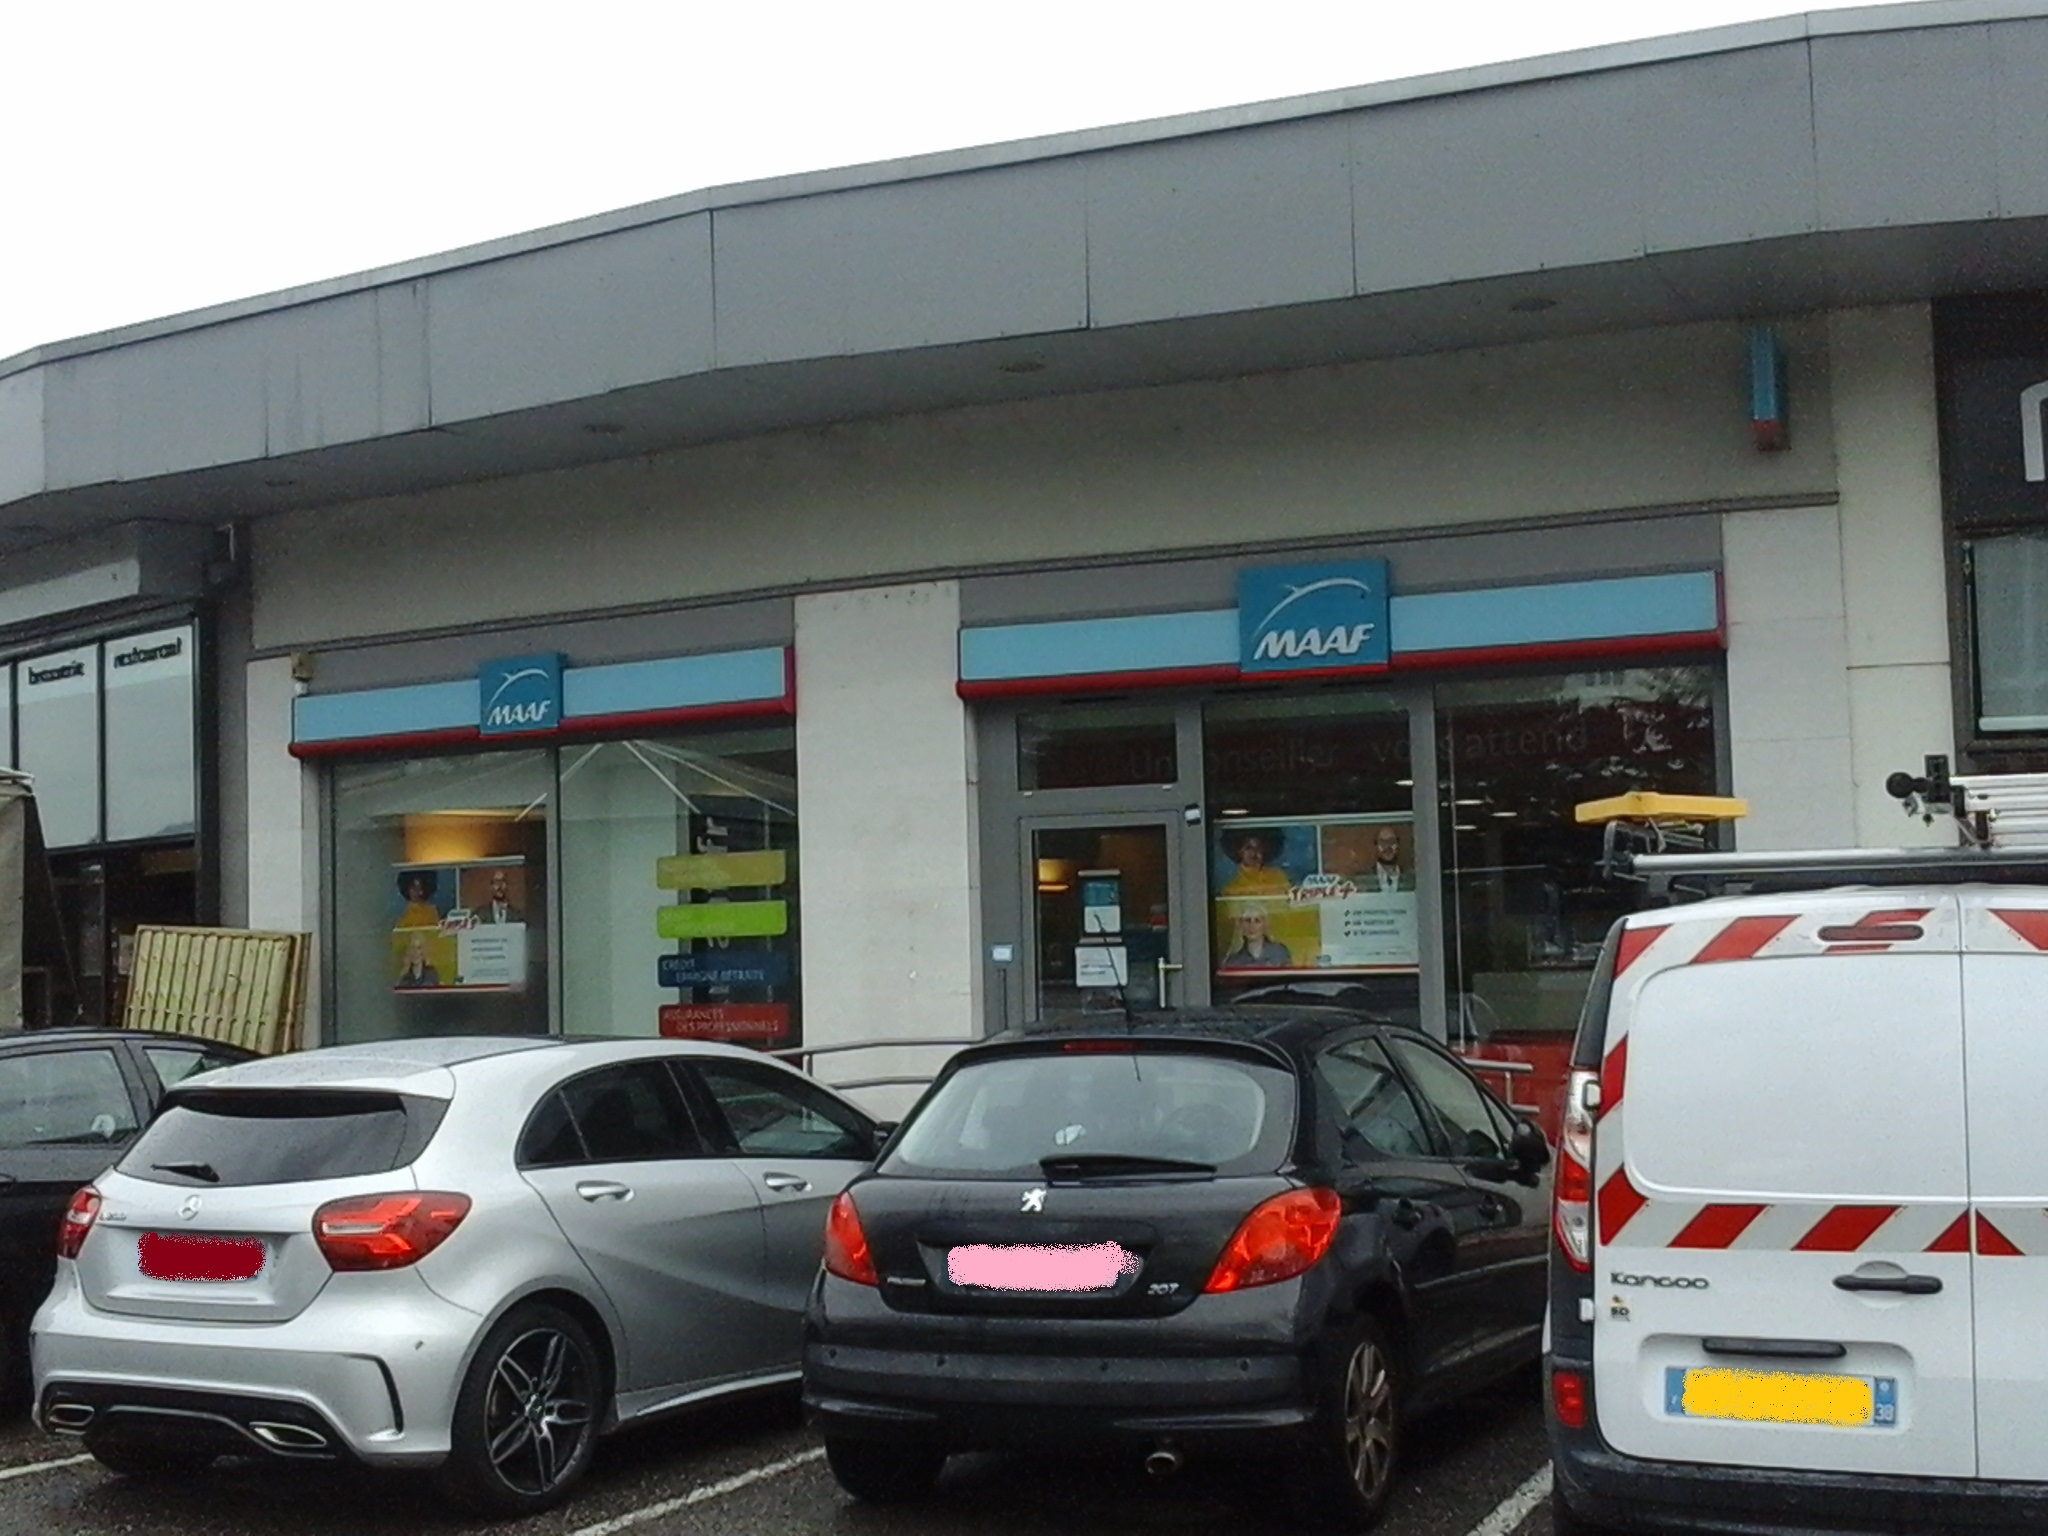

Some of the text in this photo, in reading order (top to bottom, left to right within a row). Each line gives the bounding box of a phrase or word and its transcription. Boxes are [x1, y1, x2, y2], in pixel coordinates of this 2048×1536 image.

[1253, 622, 1375, 660] MAAF
[487, 700, 551, 726] MAAF
[1205, 735, 1342, 774] onseiller
[1465, 718, 1588, 762] attend
[1147, 1282, 1180, 1295] 207
